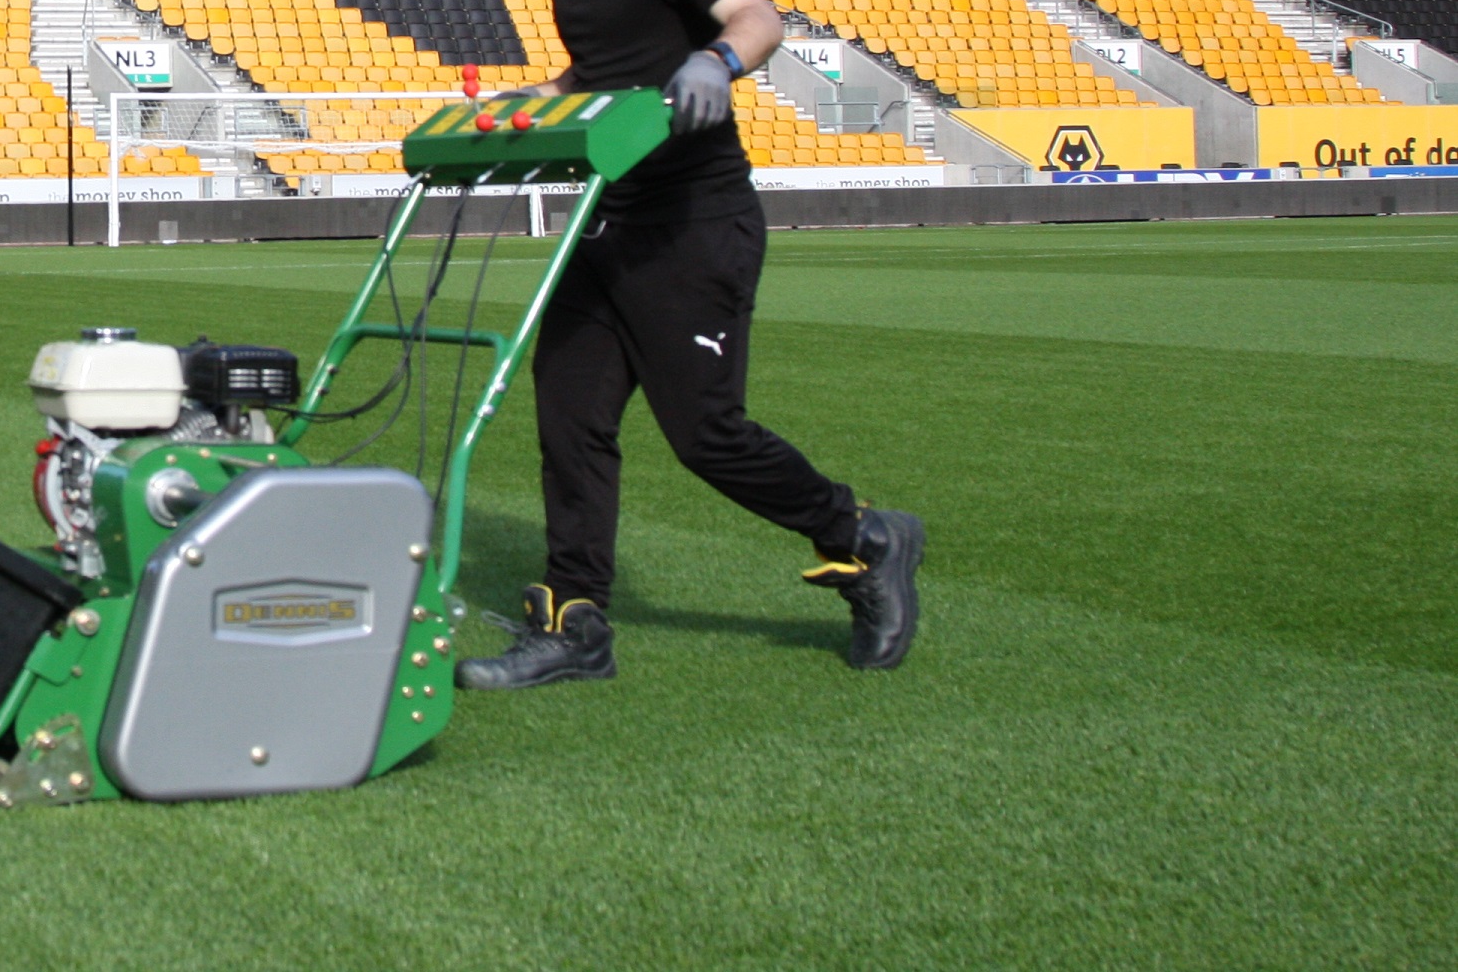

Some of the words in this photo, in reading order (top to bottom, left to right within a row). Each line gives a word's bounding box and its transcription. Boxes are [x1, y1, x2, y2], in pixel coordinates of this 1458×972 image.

[116, 50, 156, 68] NL3
[1314, 138, 1372, 167] Out
[1385, 137, 1416, 166] of
